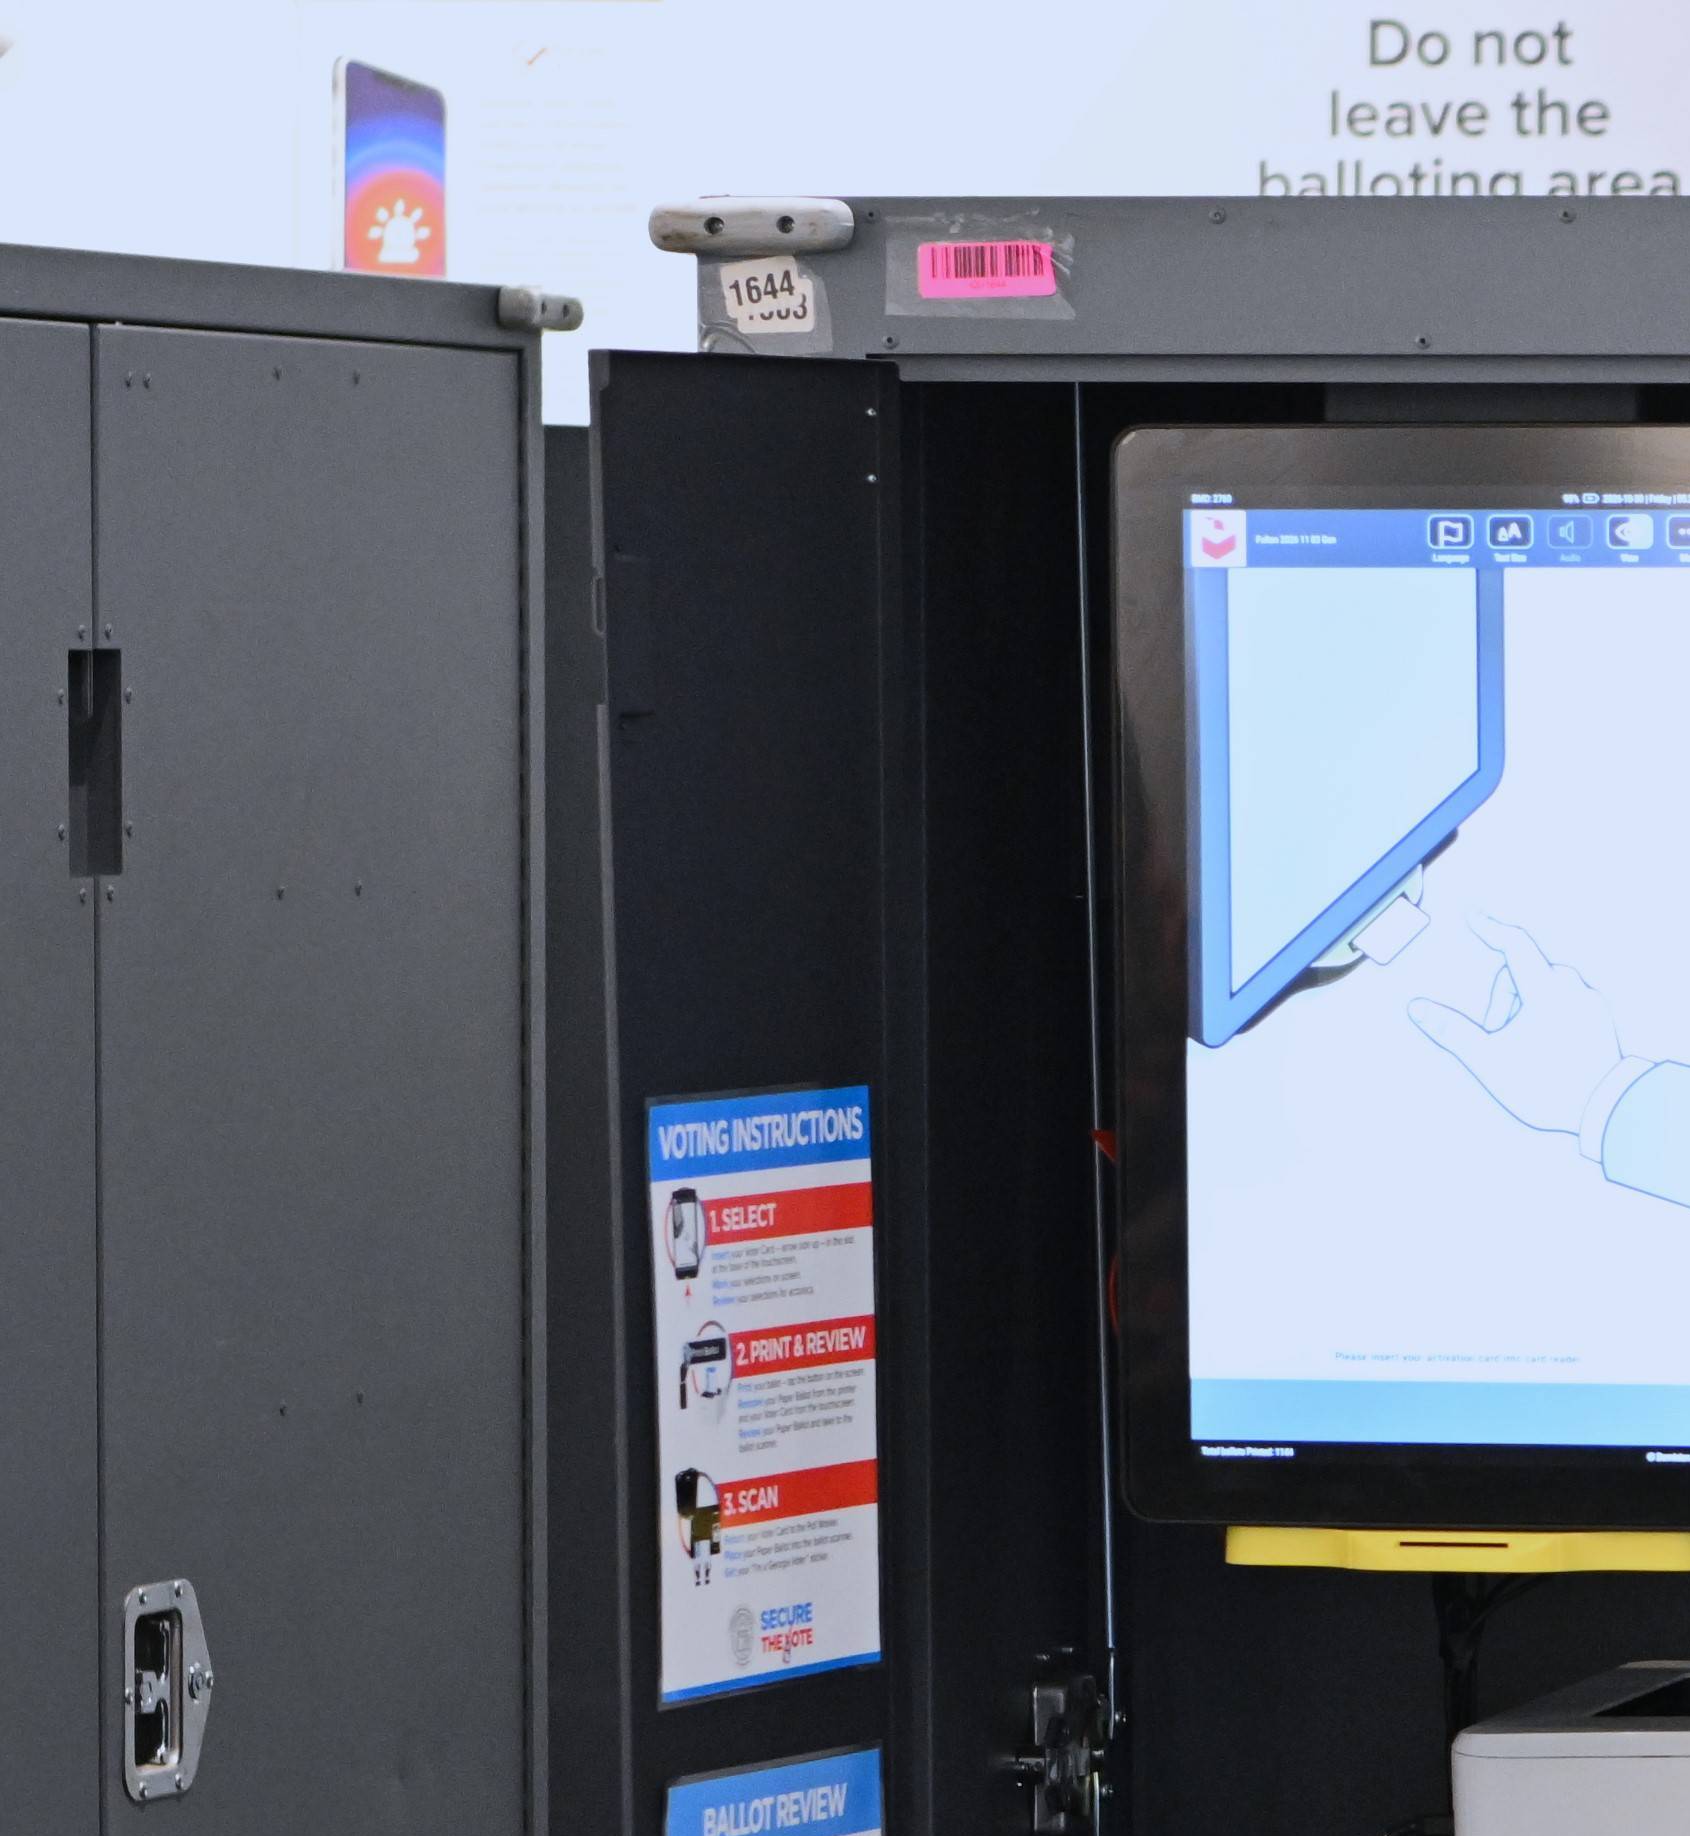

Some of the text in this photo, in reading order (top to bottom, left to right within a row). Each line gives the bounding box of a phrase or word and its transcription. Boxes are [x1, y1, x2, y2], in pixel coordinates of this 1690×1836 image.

[1368, 19, 1574, 68] Do not
[1330, 88, 1611, 137] leave the
[1259, 158, 1680, 196] balloting area
[729, 269, 795, 307] 1644
[659, 1106, 863, 1160] VOTING INSTRUCTIONS
[722, 1203, 776, 1232] SELECT
[751, 1335, 793, 1364] PRINT
[794, 1333, 806, 1356] &
[807, 1326, 866, 1354] REVIEW
[724, 1485, 780, 1516] 3. SCAN
[761, 1602, 812, 1630] SECURE
[762, 1634, 782, 1654] THE
[776, 1783, 848, 1828] REVIEW
